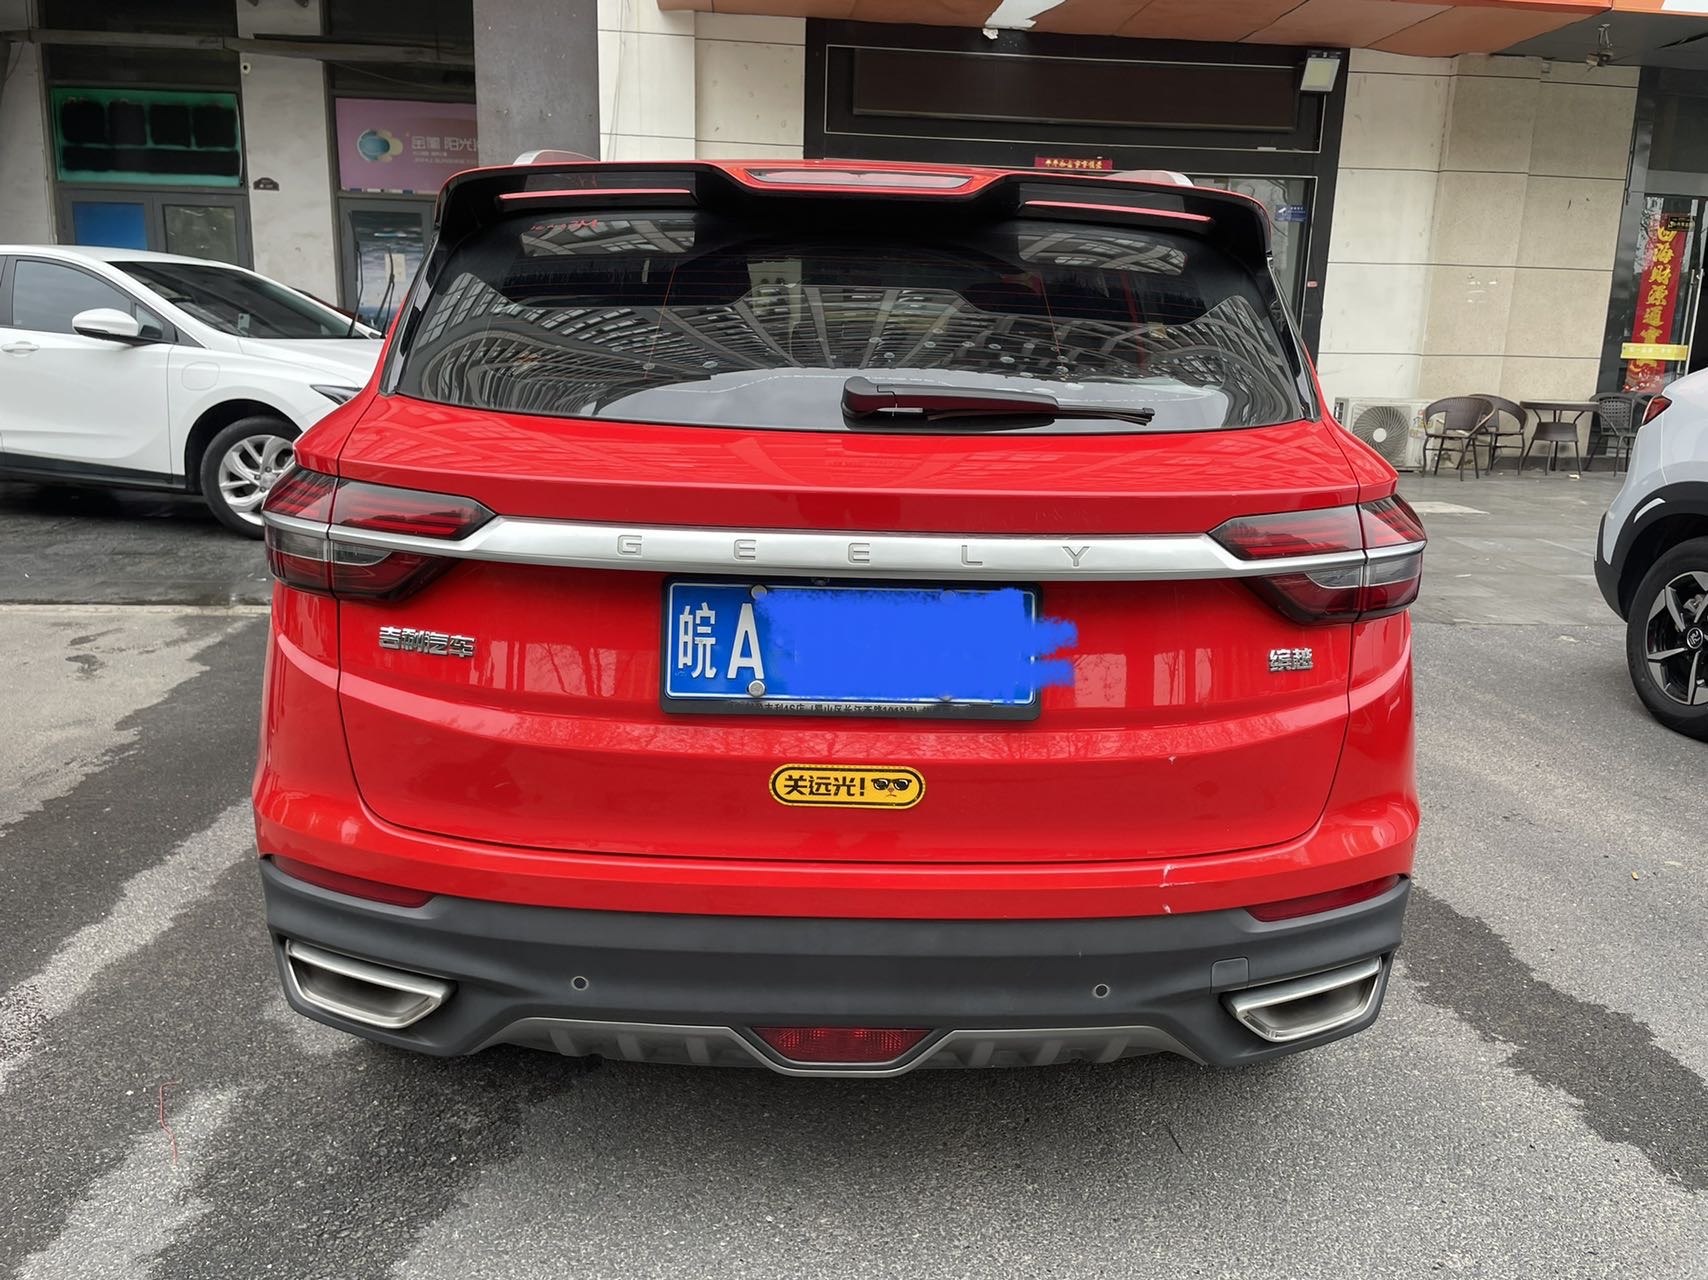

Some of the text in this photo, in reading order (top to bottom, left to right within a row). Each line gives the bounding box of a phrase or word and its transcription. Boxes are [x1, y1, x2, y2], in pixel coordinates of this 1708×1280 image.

[444, 136, 478, 152] 阳光
[616, 534, 1091, 567] GEELY
[379, 626, 475, 657] 吉利汽车
[1269, 648, 1313, 672] 缤越
[784, 774, 866, 797] 关远光!
